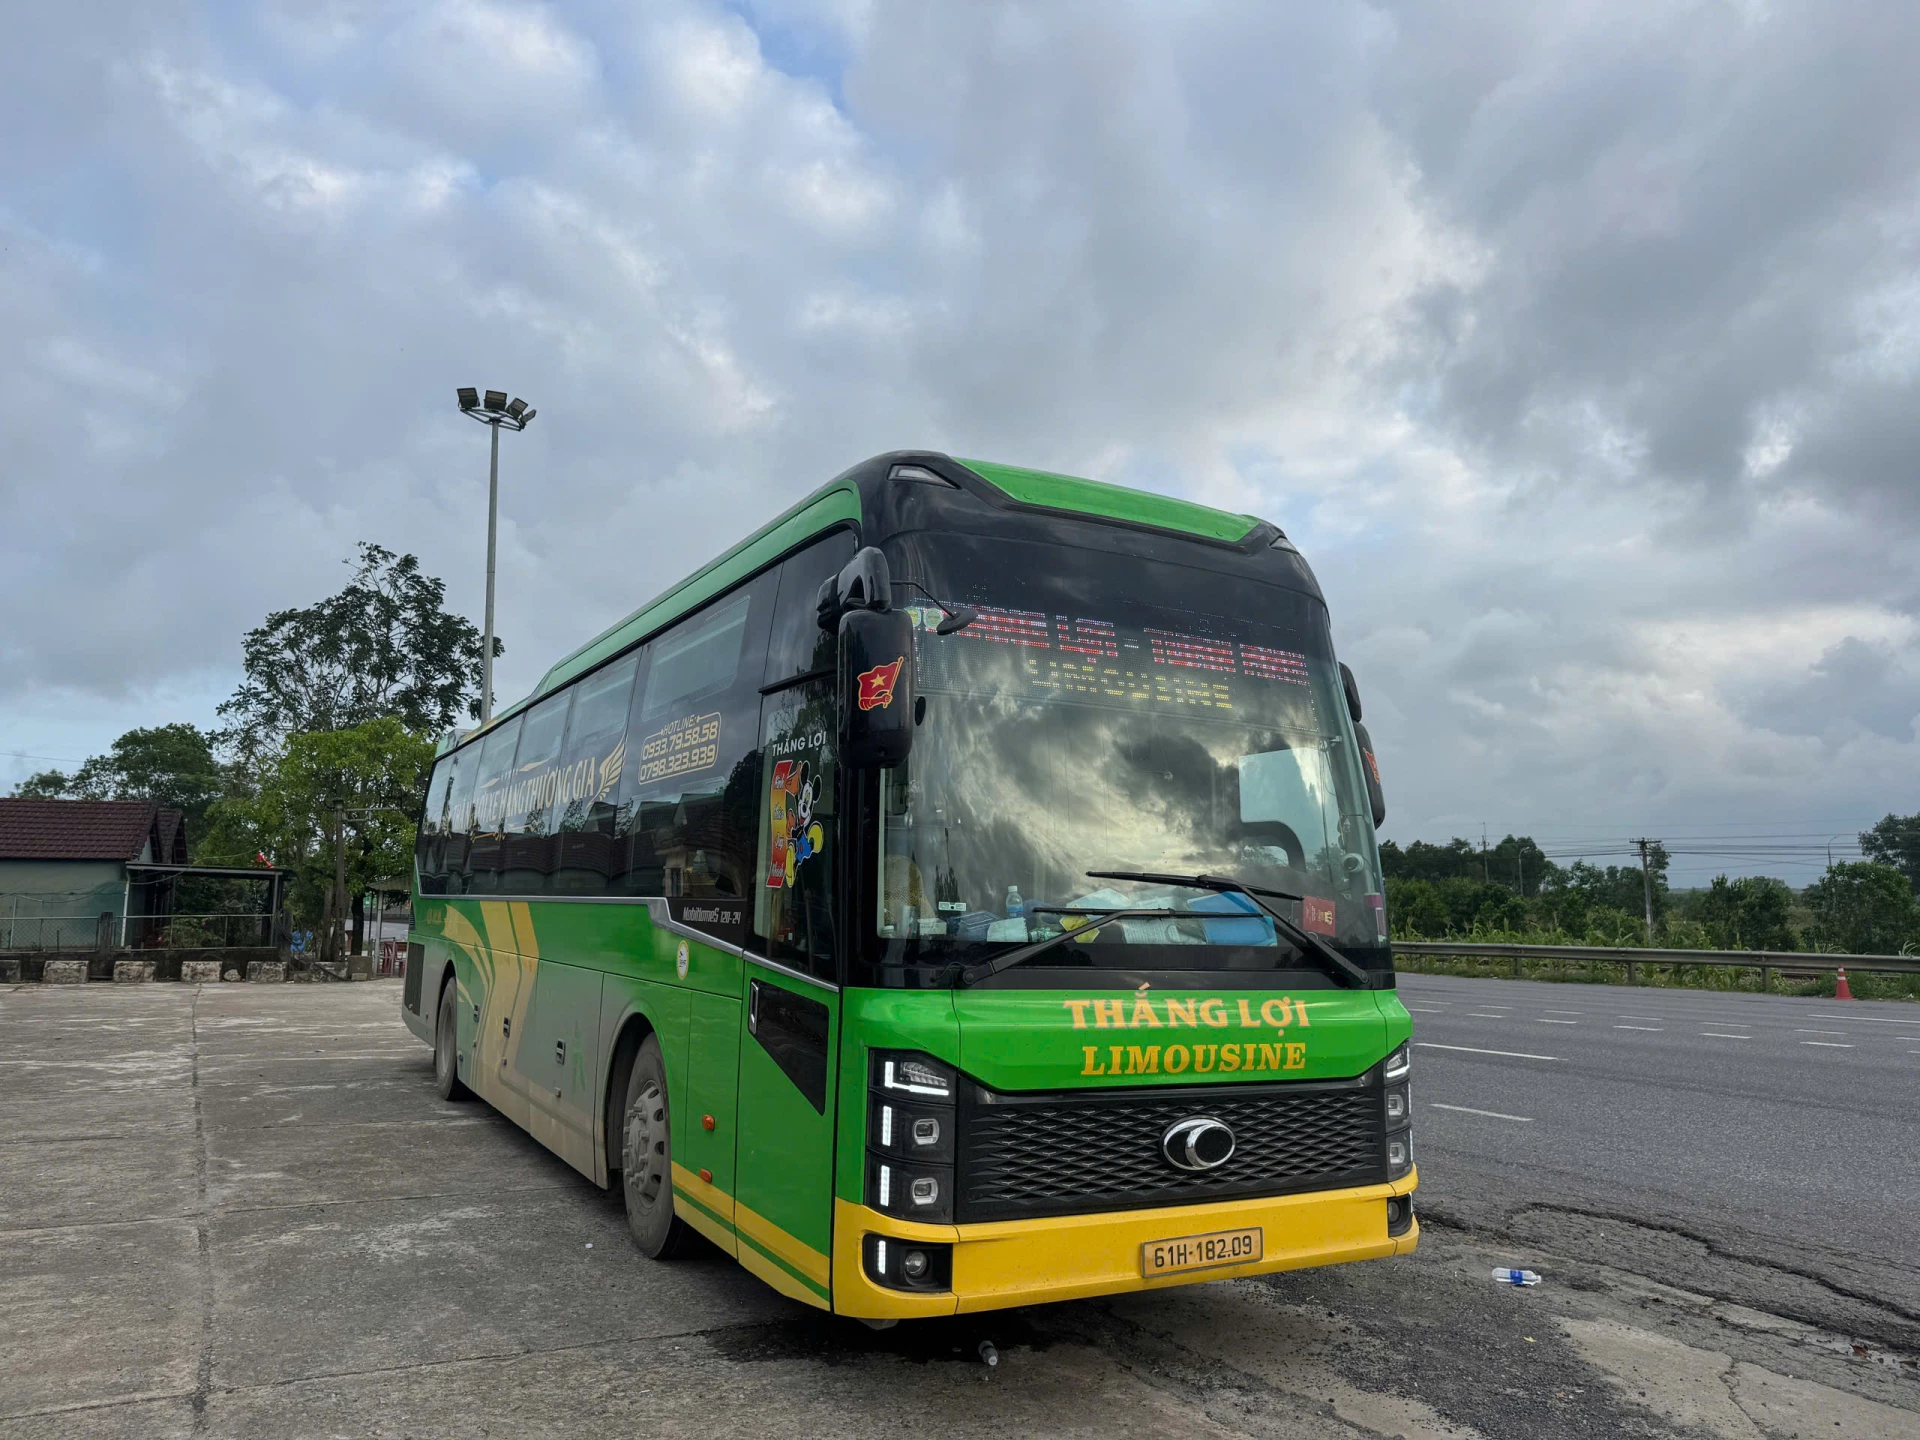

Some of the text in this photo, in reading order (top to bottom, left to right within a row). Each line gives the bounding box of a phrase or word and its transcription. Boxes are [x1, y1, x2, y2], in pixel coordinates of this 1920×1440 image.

[642, 720, 719, 760] 0933.79.58.58
[772, 730, 827, 756] THẮNG LỢI
[573, 756, 596, 801] GIA
[640, 744, 716, 780] 0798.323.939
[1063, 981, 1311, 1037] THẮNG LỢI
[1080, 1042, 1306, 1076] LIMOUSINE
[1154, 1235, 1252, 1268] 61H-182.09
